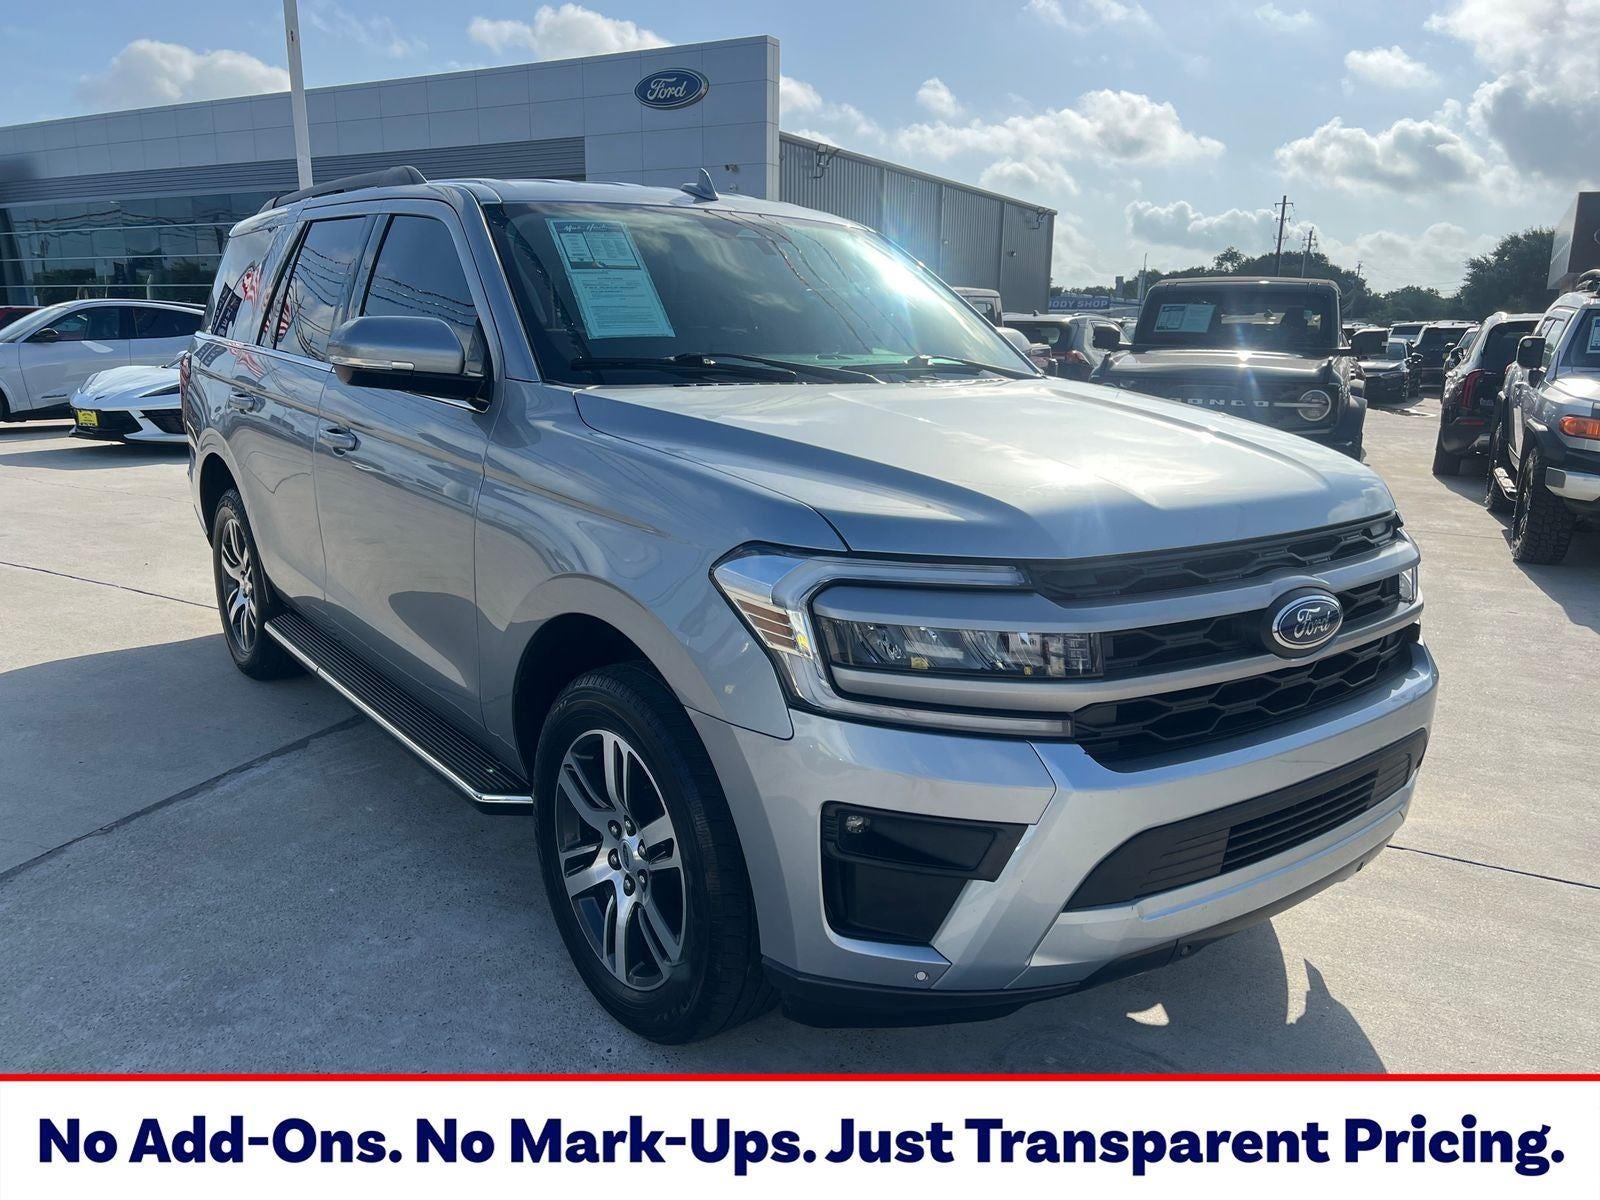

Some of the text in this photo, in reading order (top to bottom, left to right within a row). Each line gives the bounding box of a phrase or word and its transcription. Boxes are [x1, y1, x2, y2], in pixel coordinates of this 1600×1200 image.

[647, 77, 687, 100] Ford
[1077, 300, 1108, 308] SHOP
[1294, 606, 1331, 638] Ford
